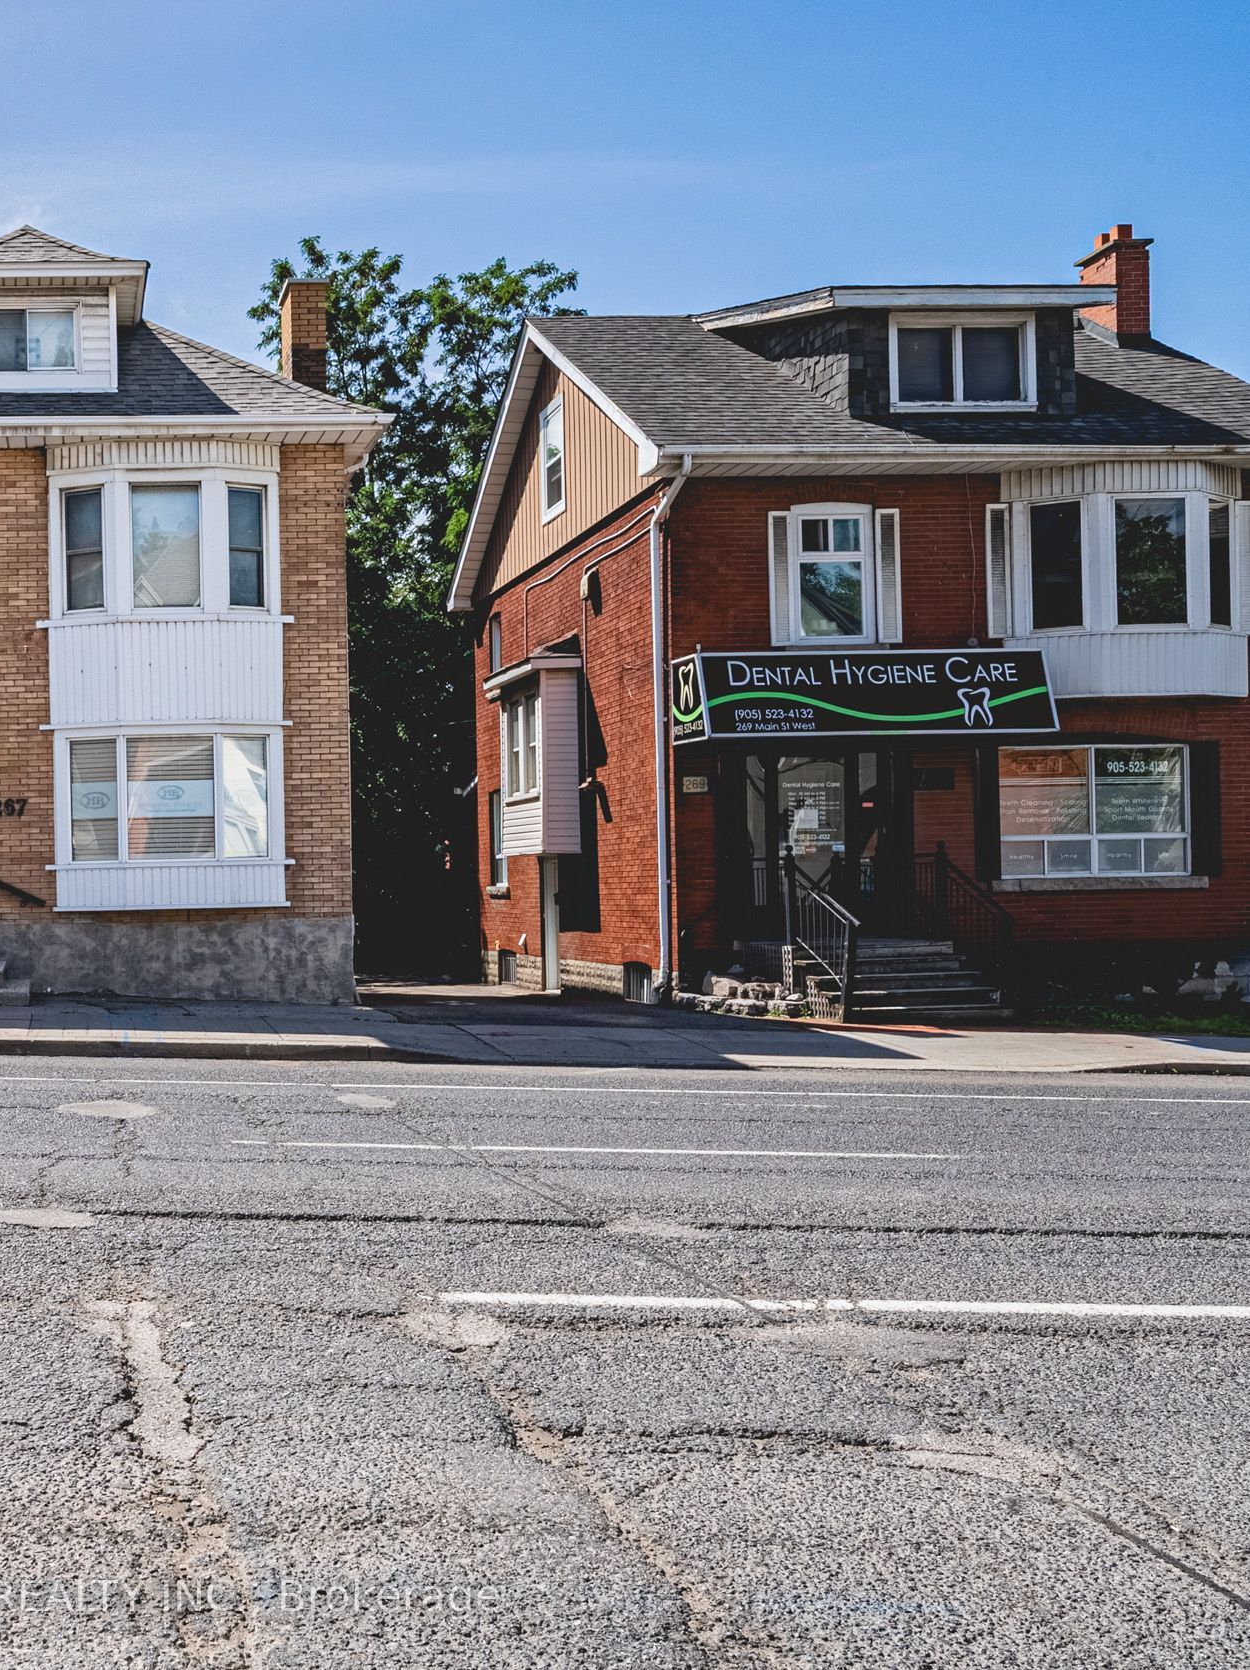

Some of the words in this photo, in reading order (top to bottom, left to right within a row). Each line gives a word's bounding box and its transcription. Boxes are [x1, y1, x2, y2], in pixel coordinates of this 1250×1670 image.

[726, 660, 822, 686] DENTAL
[829, 659, 937, 685] HYGIENE
[945, 656, 1019, 683] CARE
[734, 708, 762, 721] (905)
[765, 708, 814, 719] 523-4132
[735, 723, 753, 732] 269
[755, 722, 780, 731] Main
[781, 722, 791, 731] St
[792, 722, 816, 730] West
[1106, 761, 1169, 773] 905-523-4132
[685, 779, 706, 790] 269
